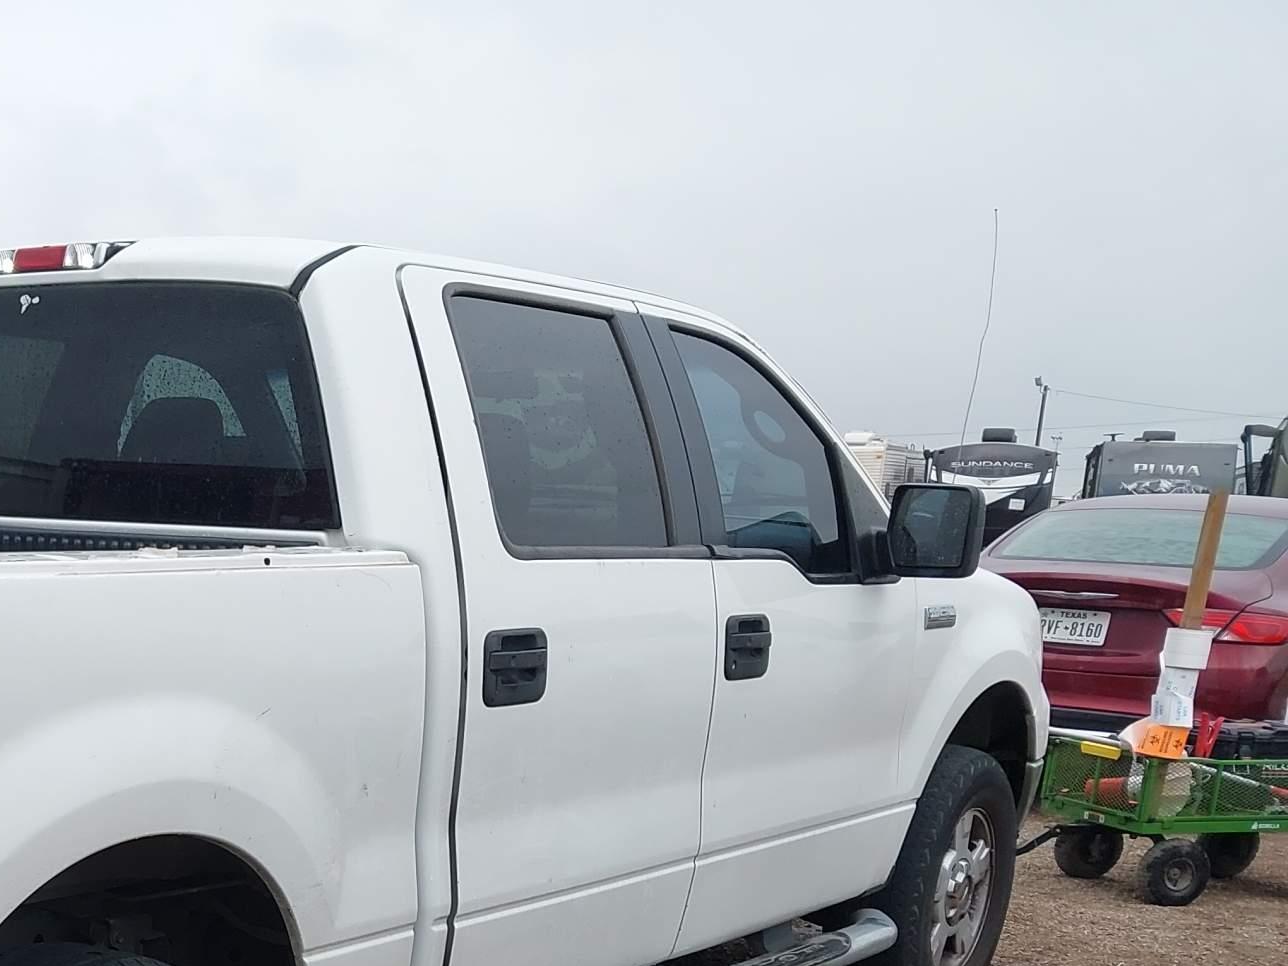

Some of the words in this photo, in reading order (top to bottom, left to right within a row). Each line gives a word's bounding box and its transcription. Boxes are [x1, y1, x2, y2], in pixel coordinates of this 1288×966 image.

[951, 460, 1035, 470] SUNDANCE
[1133, 463, 1201, 476] PUMA
[1060, 611, 1089, 620] TEXAS
